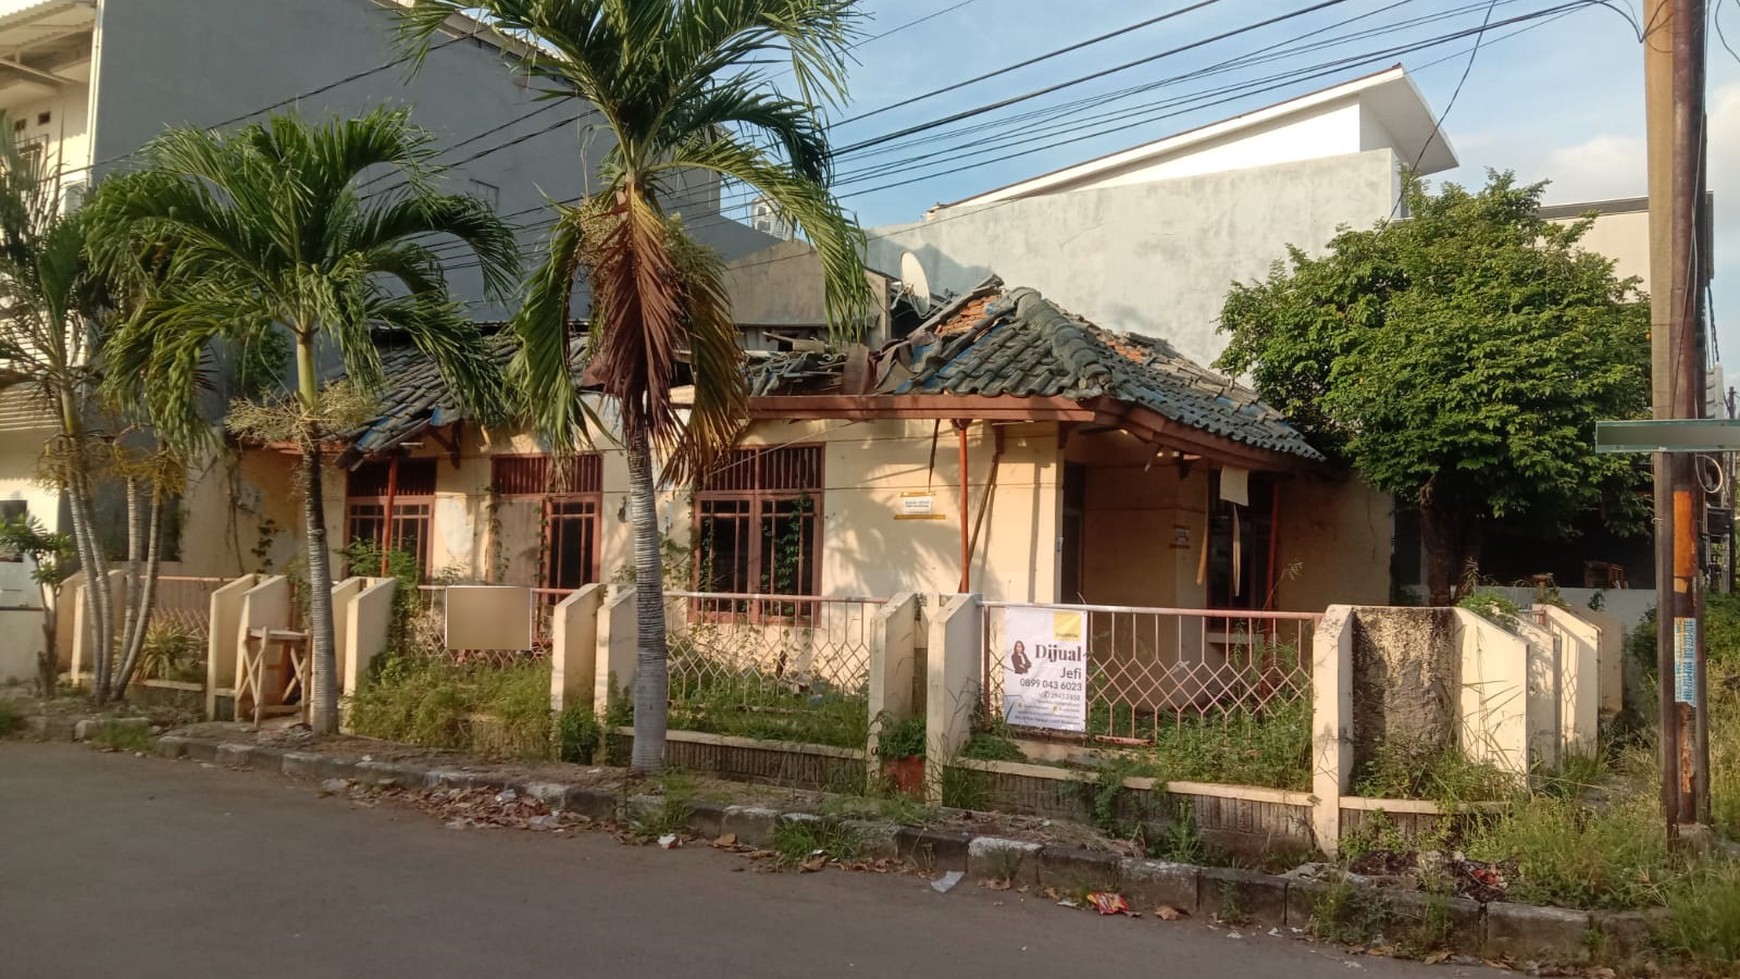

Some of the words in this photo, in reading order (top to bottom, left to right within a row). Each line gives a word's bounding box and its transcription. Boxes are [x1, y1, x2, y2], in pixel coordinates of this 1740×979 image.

[1035, 644, 1082, 663] Dijual
[1060, 667, 1082, 679] Jefi
[1020, 678, 1041, 688] 0899
[1042, 681, 1059, 689] 043
[1060, 682, 1082, 691] 6023
